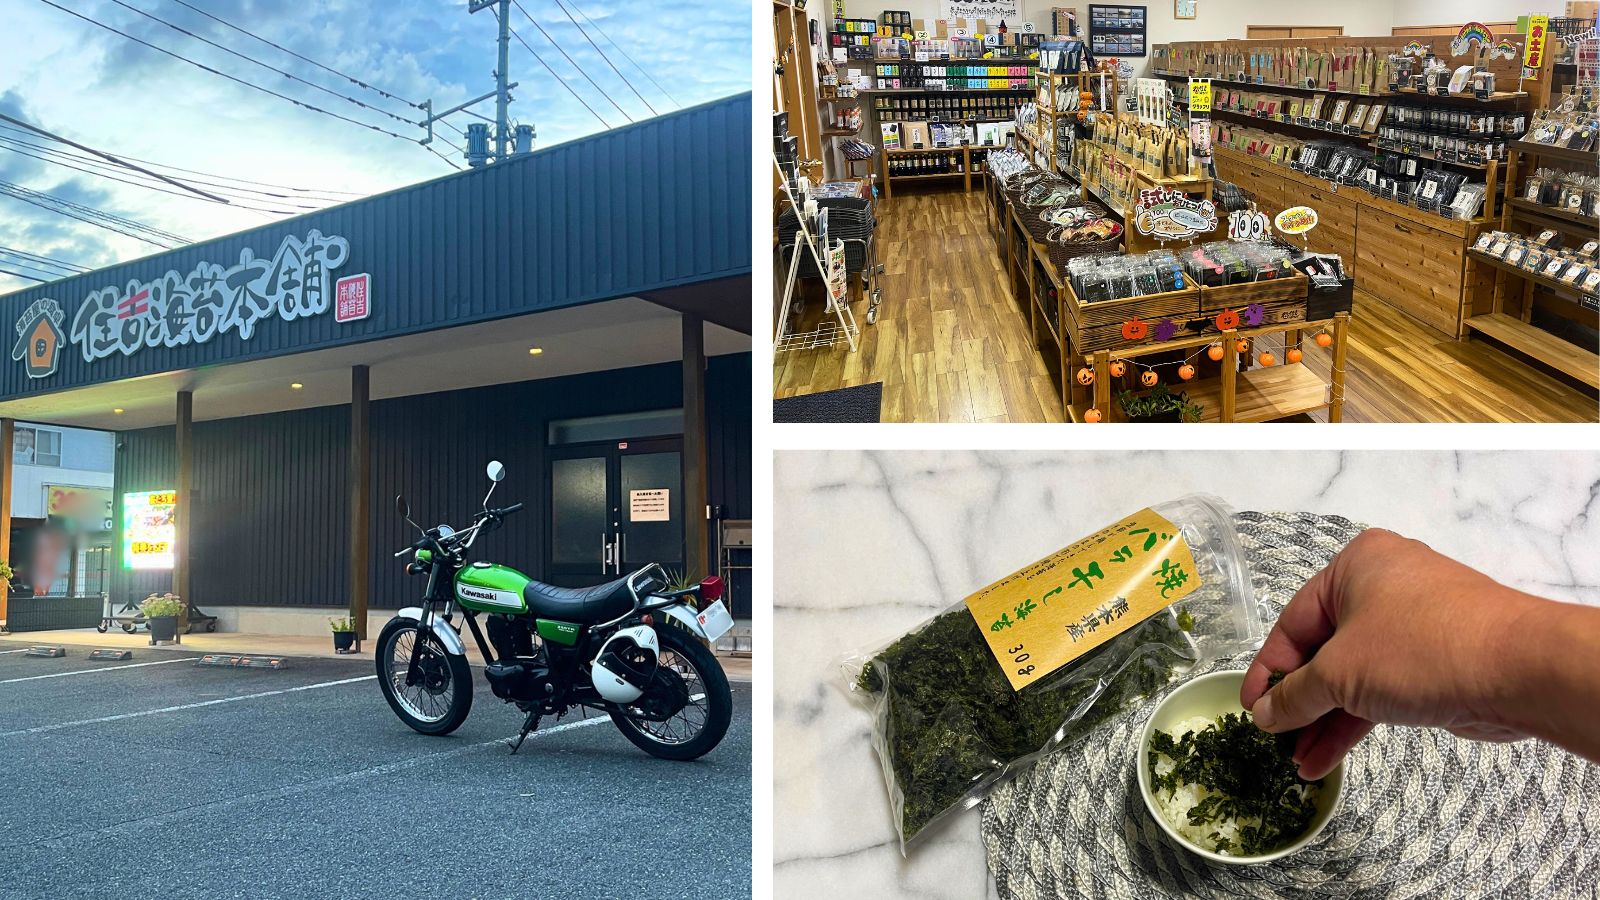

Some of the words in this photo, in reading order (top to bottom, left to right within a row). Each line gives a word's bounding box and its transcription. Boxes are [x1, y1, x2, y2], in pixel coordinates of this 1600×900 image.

[1527, 25, 1543, 66] お土産
[1564, 27, 1596, 44] New!!
[1141, 186, 1182, 209] 試しに
[72, 231, 345, 358] 住吉海苔本舗
[461, 587, 497, 601] Kawasaki
[990, 528, 1174, 633] バラ干し海苔
[1152, 558, 1190, 600] 焼
[1065, 595, 1132, 643] 熊本県産
[1008, 643, 1036, 677] 30g
